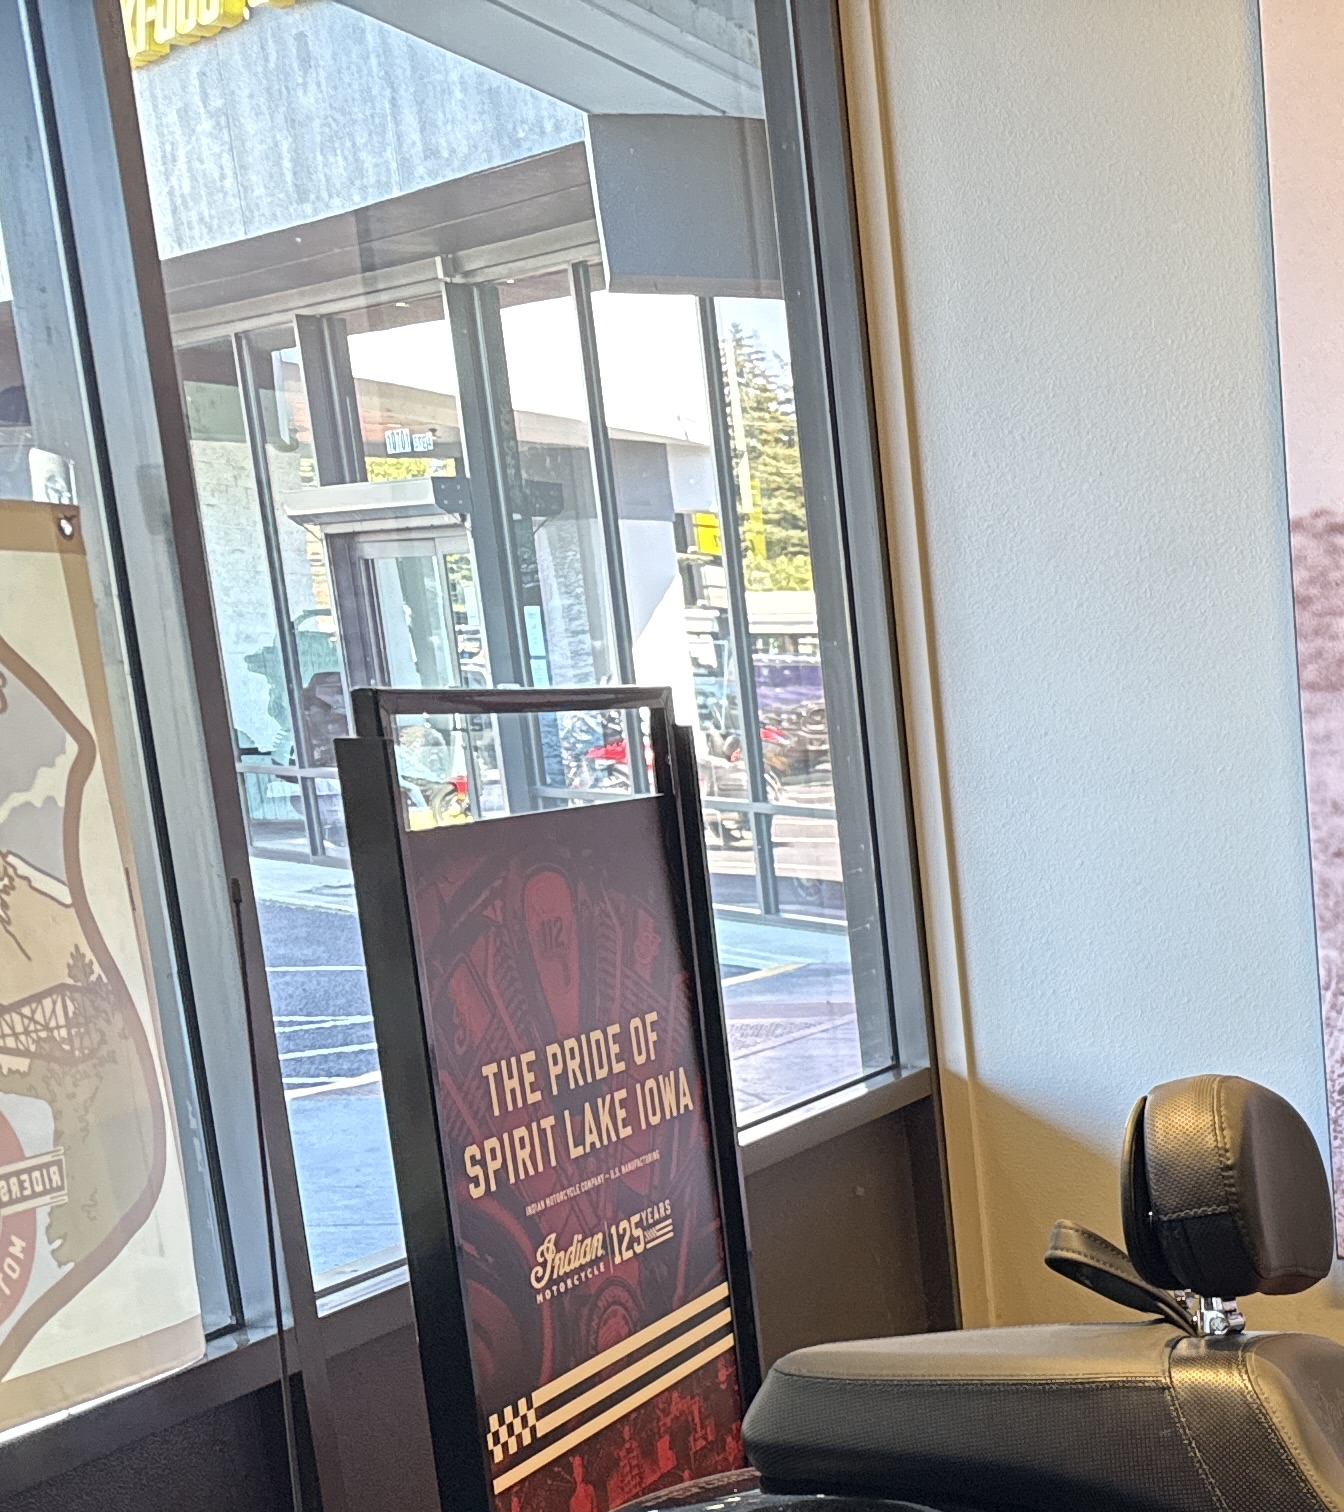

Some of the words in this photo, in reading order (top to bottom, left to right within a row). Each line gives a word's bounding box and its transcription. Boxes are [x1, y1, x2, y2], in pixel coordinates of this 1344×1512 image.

[482, 1051, 542, 1117] THE
[546, 1023, 626, 1096] PRIDE
[629, 1011, 659, 1066] OF
[464, 1115, 557, 1199] SPIRIT
[563, 1088, 633, 1160] LAKE
[635, 1066, 694, 1130] IOWA
[525, 1200, 545, 1217] INDIAN
[545, 1184, 580, 1207] MOTORCYCLE
[580, 1173, 605, 1192] COMPANY
[621, 1150, 661, 1174] MANUFACTURING
[530, 1232, 604, 1289] Indian
[610, 1214, 647, 1265] 125
[640, 1199, 672, 1226] YEARS
[536, 1261, 605, 1304] MOTORCYCLE
